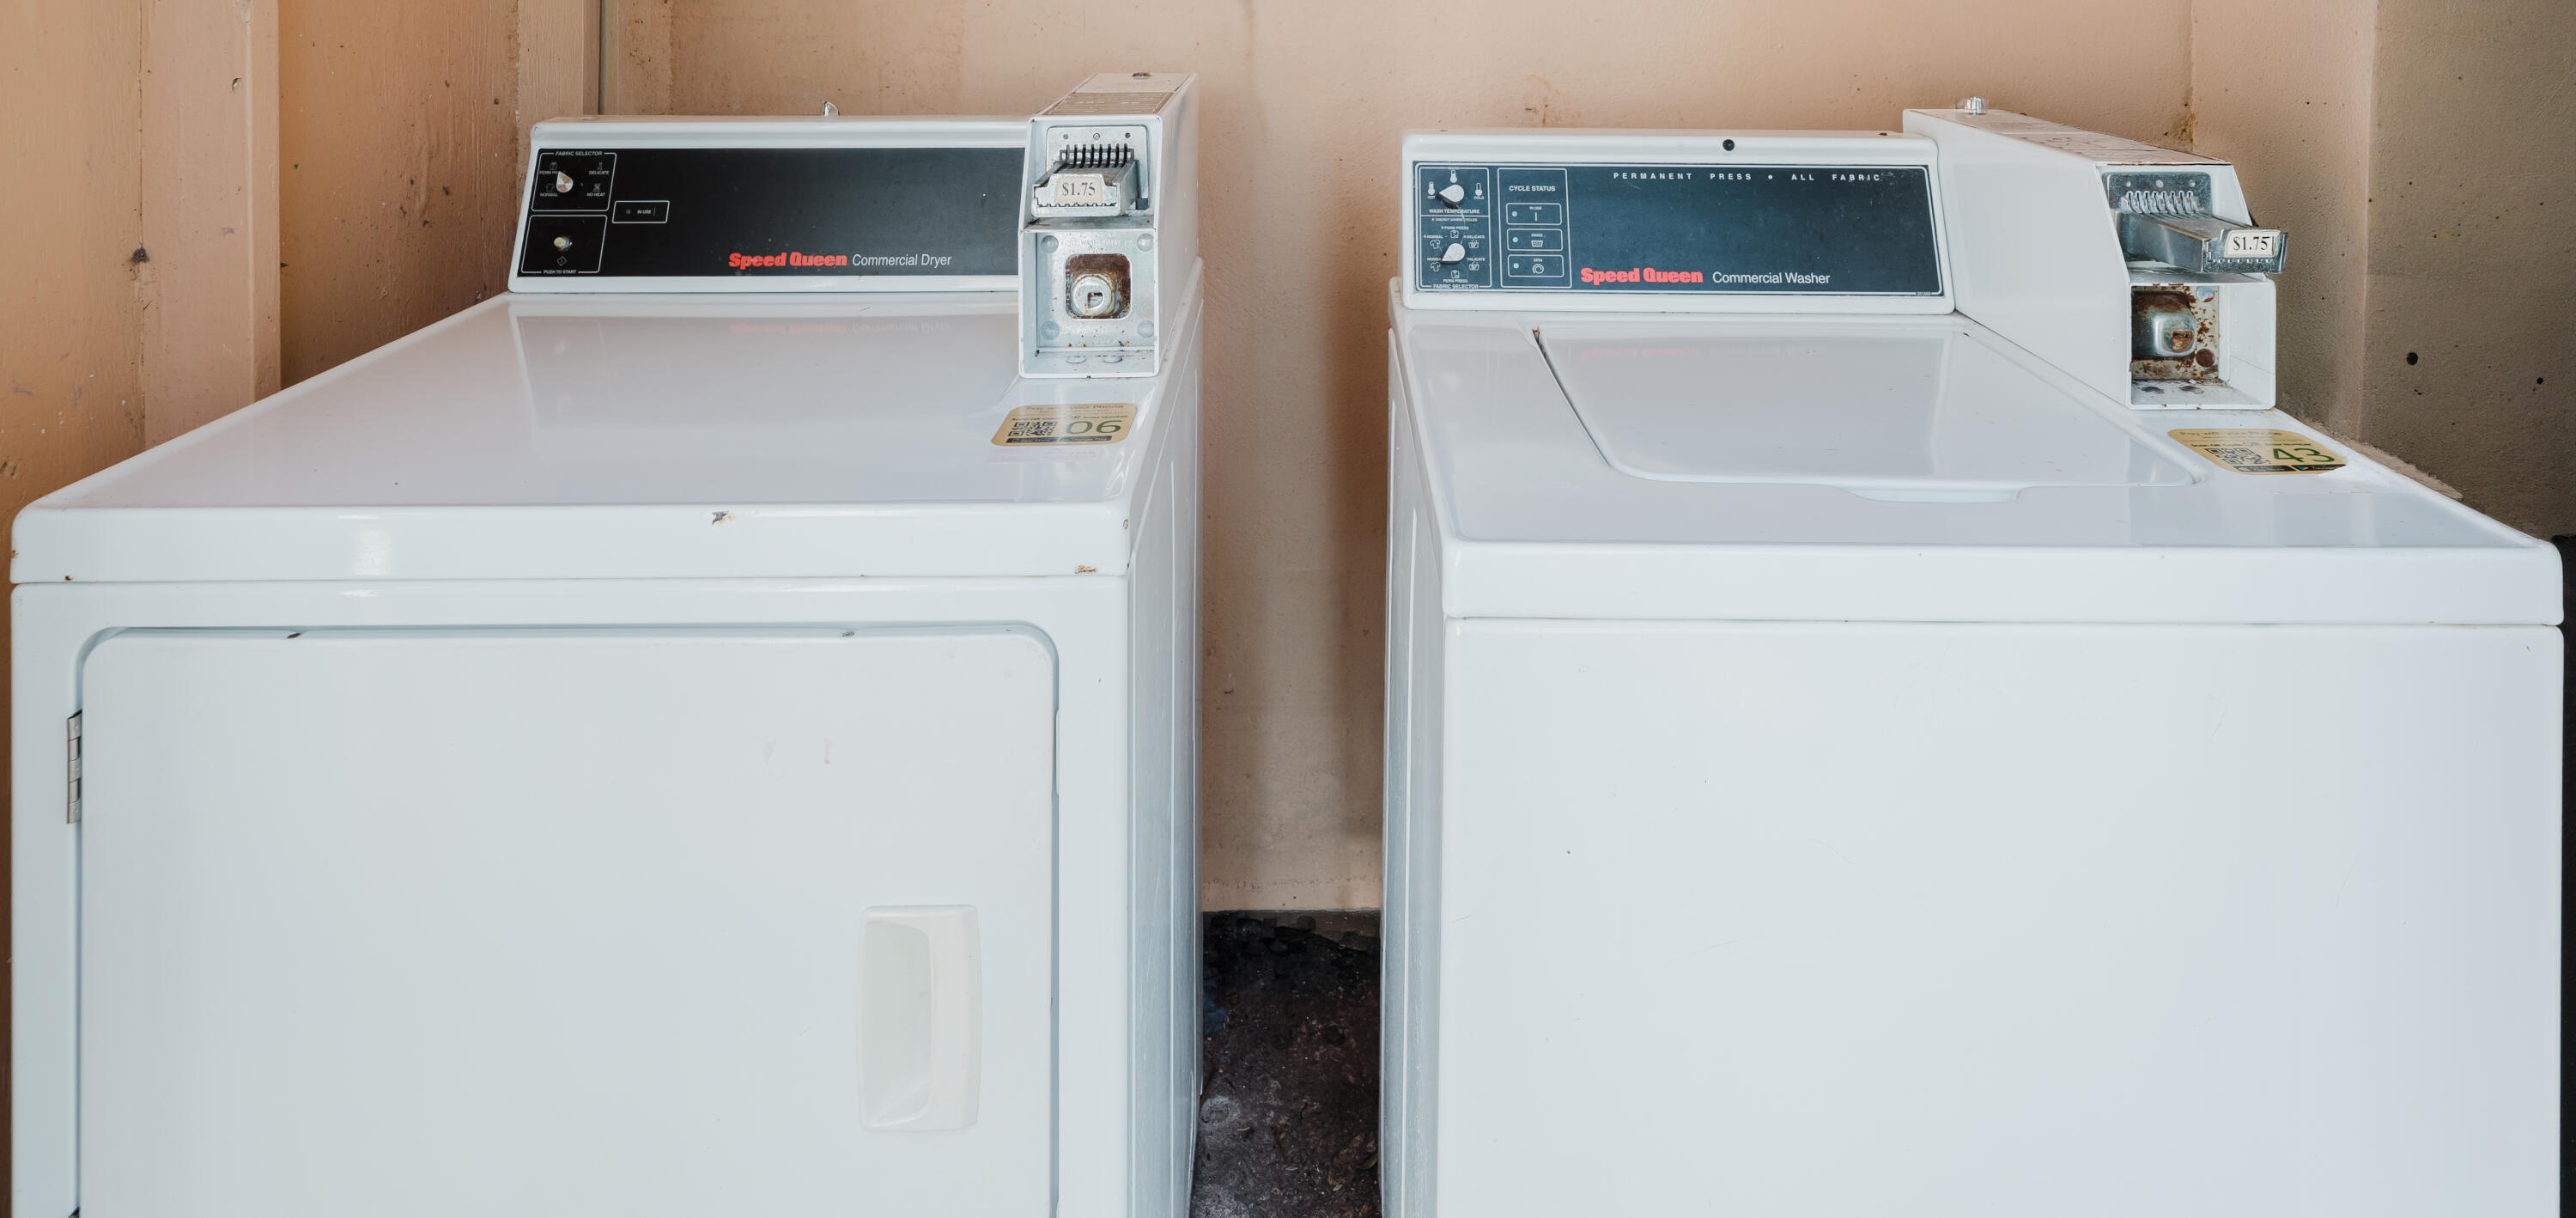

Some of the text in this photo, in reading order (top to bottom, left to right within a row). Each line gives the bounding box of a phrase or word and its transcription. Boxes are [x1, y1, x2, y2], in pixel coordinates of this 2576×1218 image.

[1061, 181, 1096, 196] $1.75
[2233, 235, 2270, 250] $1.75
[728, 252, 952, 270] Speed Queen Commercial Dryer
[1580, 267, 1830, 285] Speed Queen Commercial Washer
[1065, 419, 1123, 435] 06
[2273, 448, 2336, 463] 43
